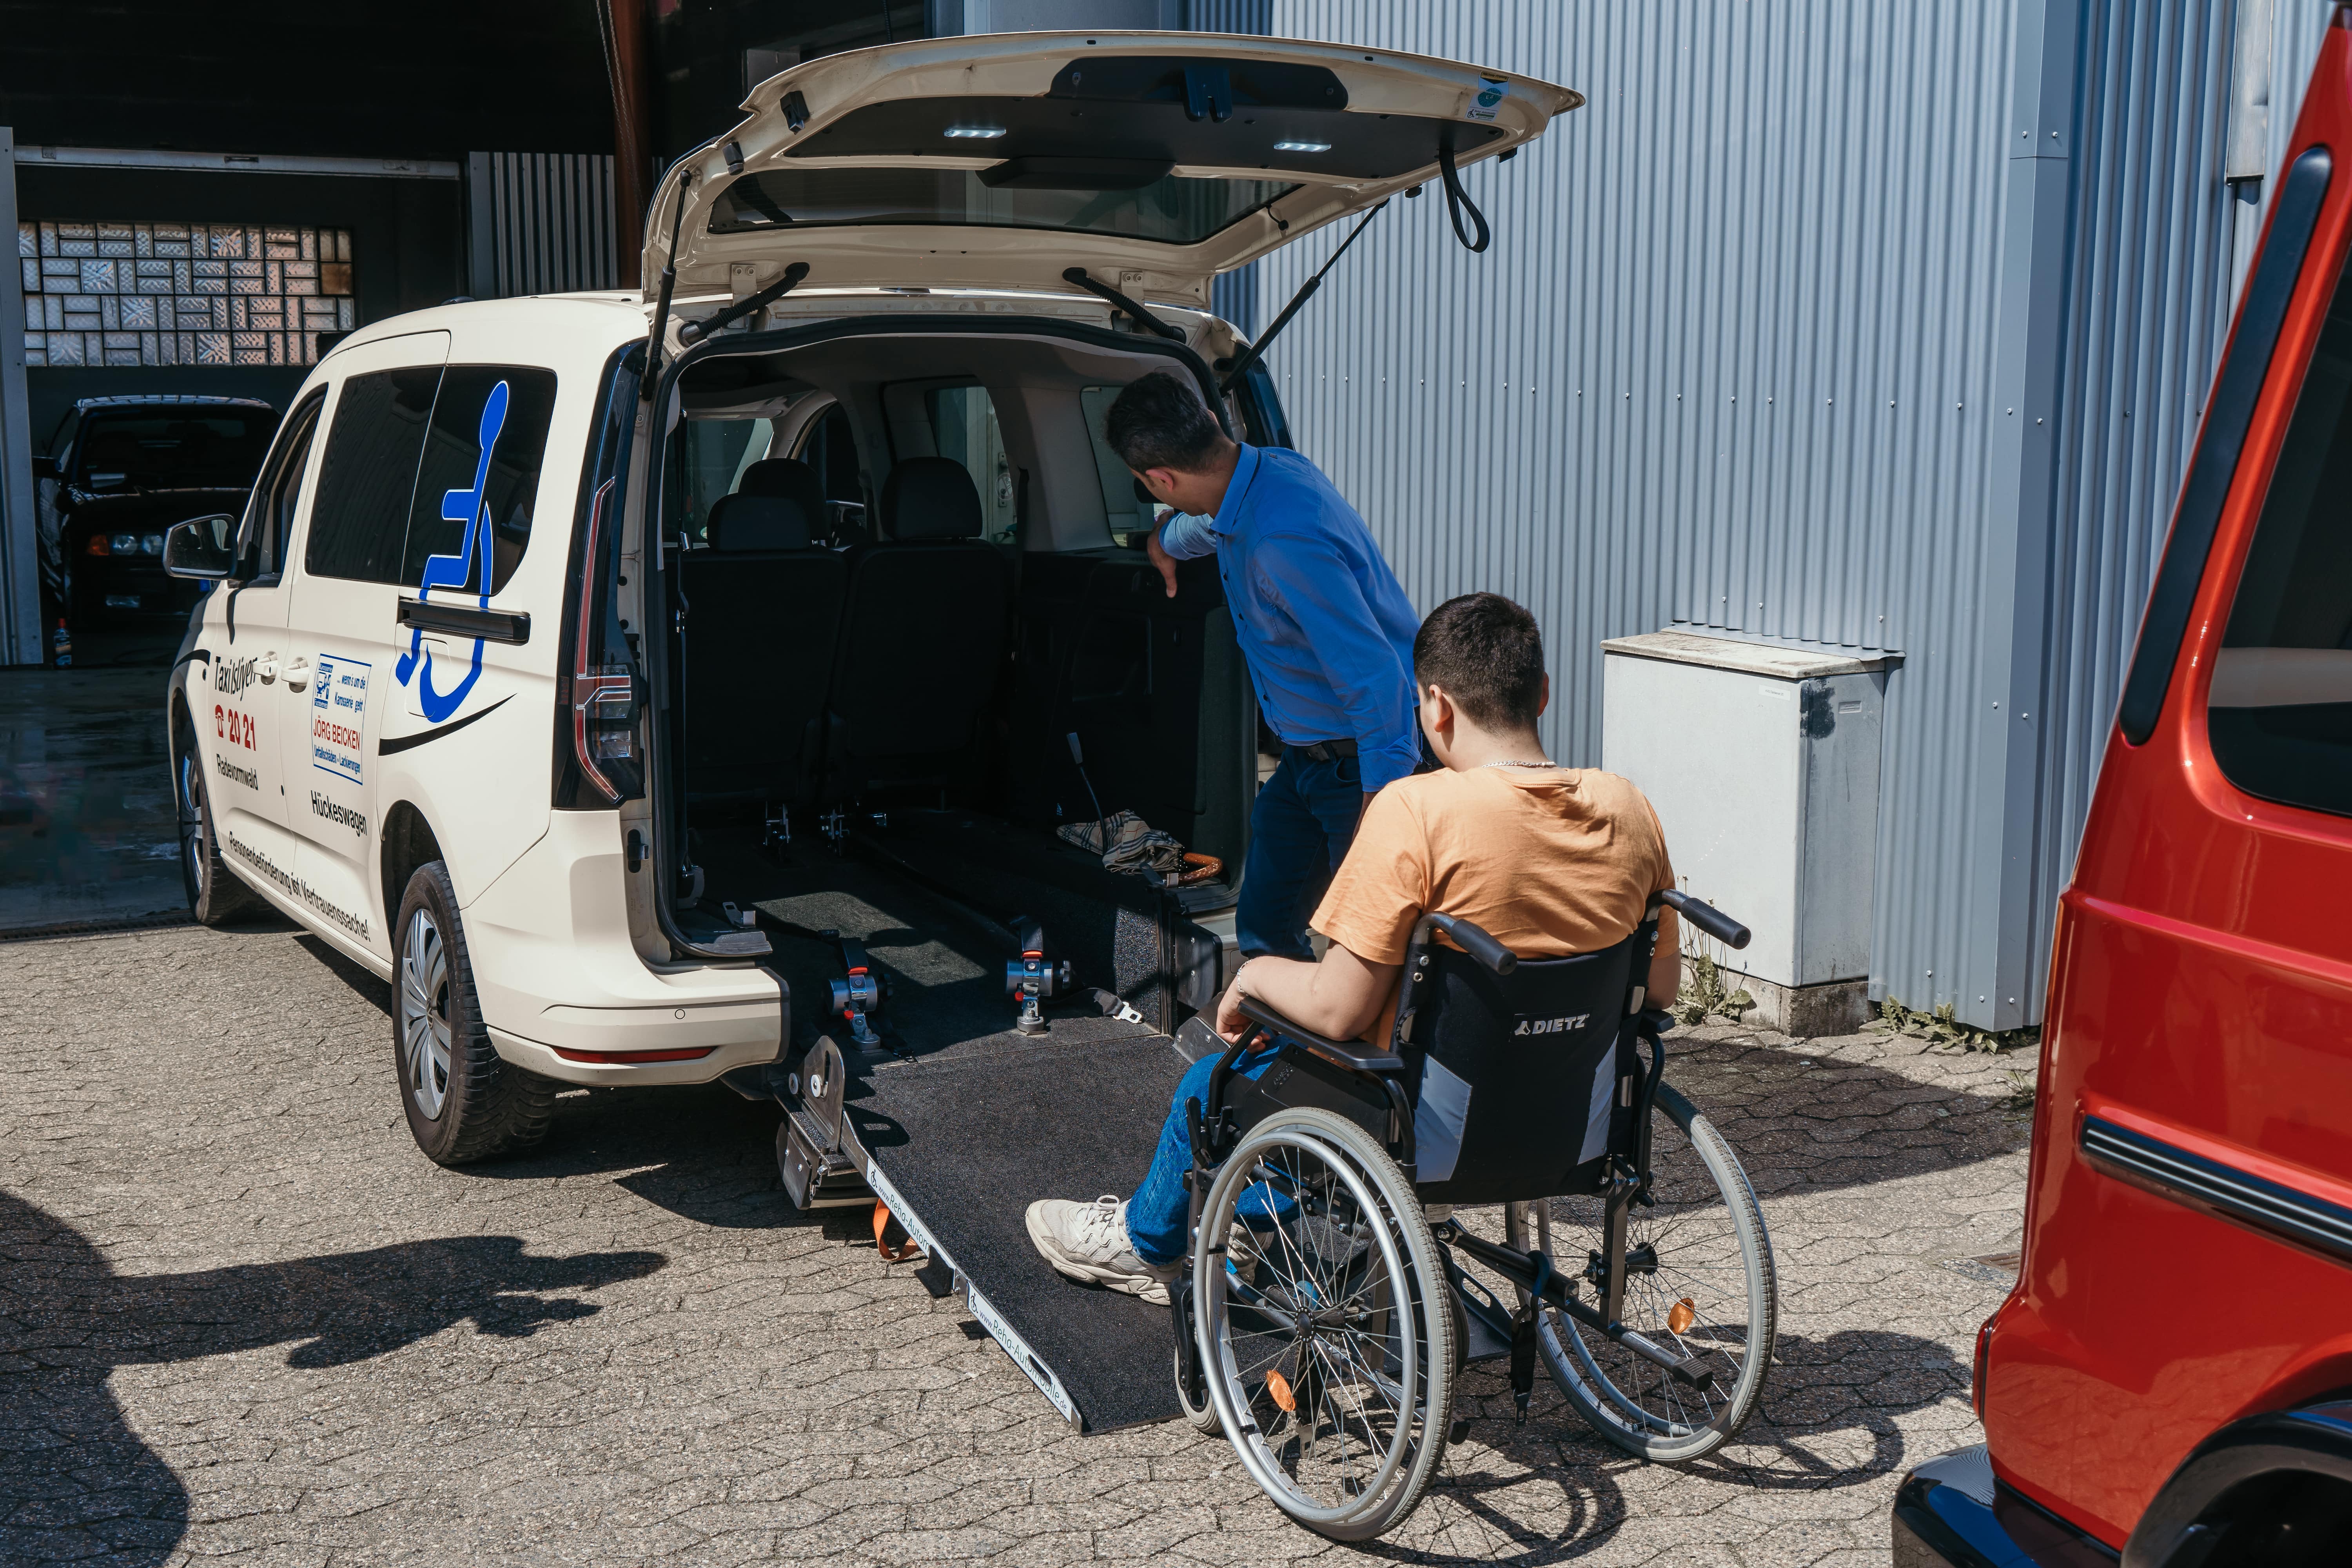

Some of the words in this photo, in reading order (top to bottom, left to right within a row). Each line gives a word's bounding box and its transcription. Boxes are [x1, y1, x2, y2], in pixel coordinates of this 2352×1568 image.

[215, 656, 232, 693] Taxi
[334, 691, 353, 709] Karosserie
[354, 698, 363, 713] geht
[228, 709, 240, 745] 20
[243, 714, 256, 751] 21
[314, 715, 330, 740] JÖRG
[332, 724, 360, 751] BEICKEN
[216, 753, 258, 791] Radevormwald
[314, 744, 337, 764] Unfallschäden
[339, 753, 361, 775] Lackierungen
[311, 790, 367, 837] Hückeswagen
[229, 831, 292, 895] Personenbeförderung
[291, 872, 301, 898] ist
[301, 879, 371, 942] Vertrauenssache!
[1532, 1014, 1586, 1034] DIETZ
